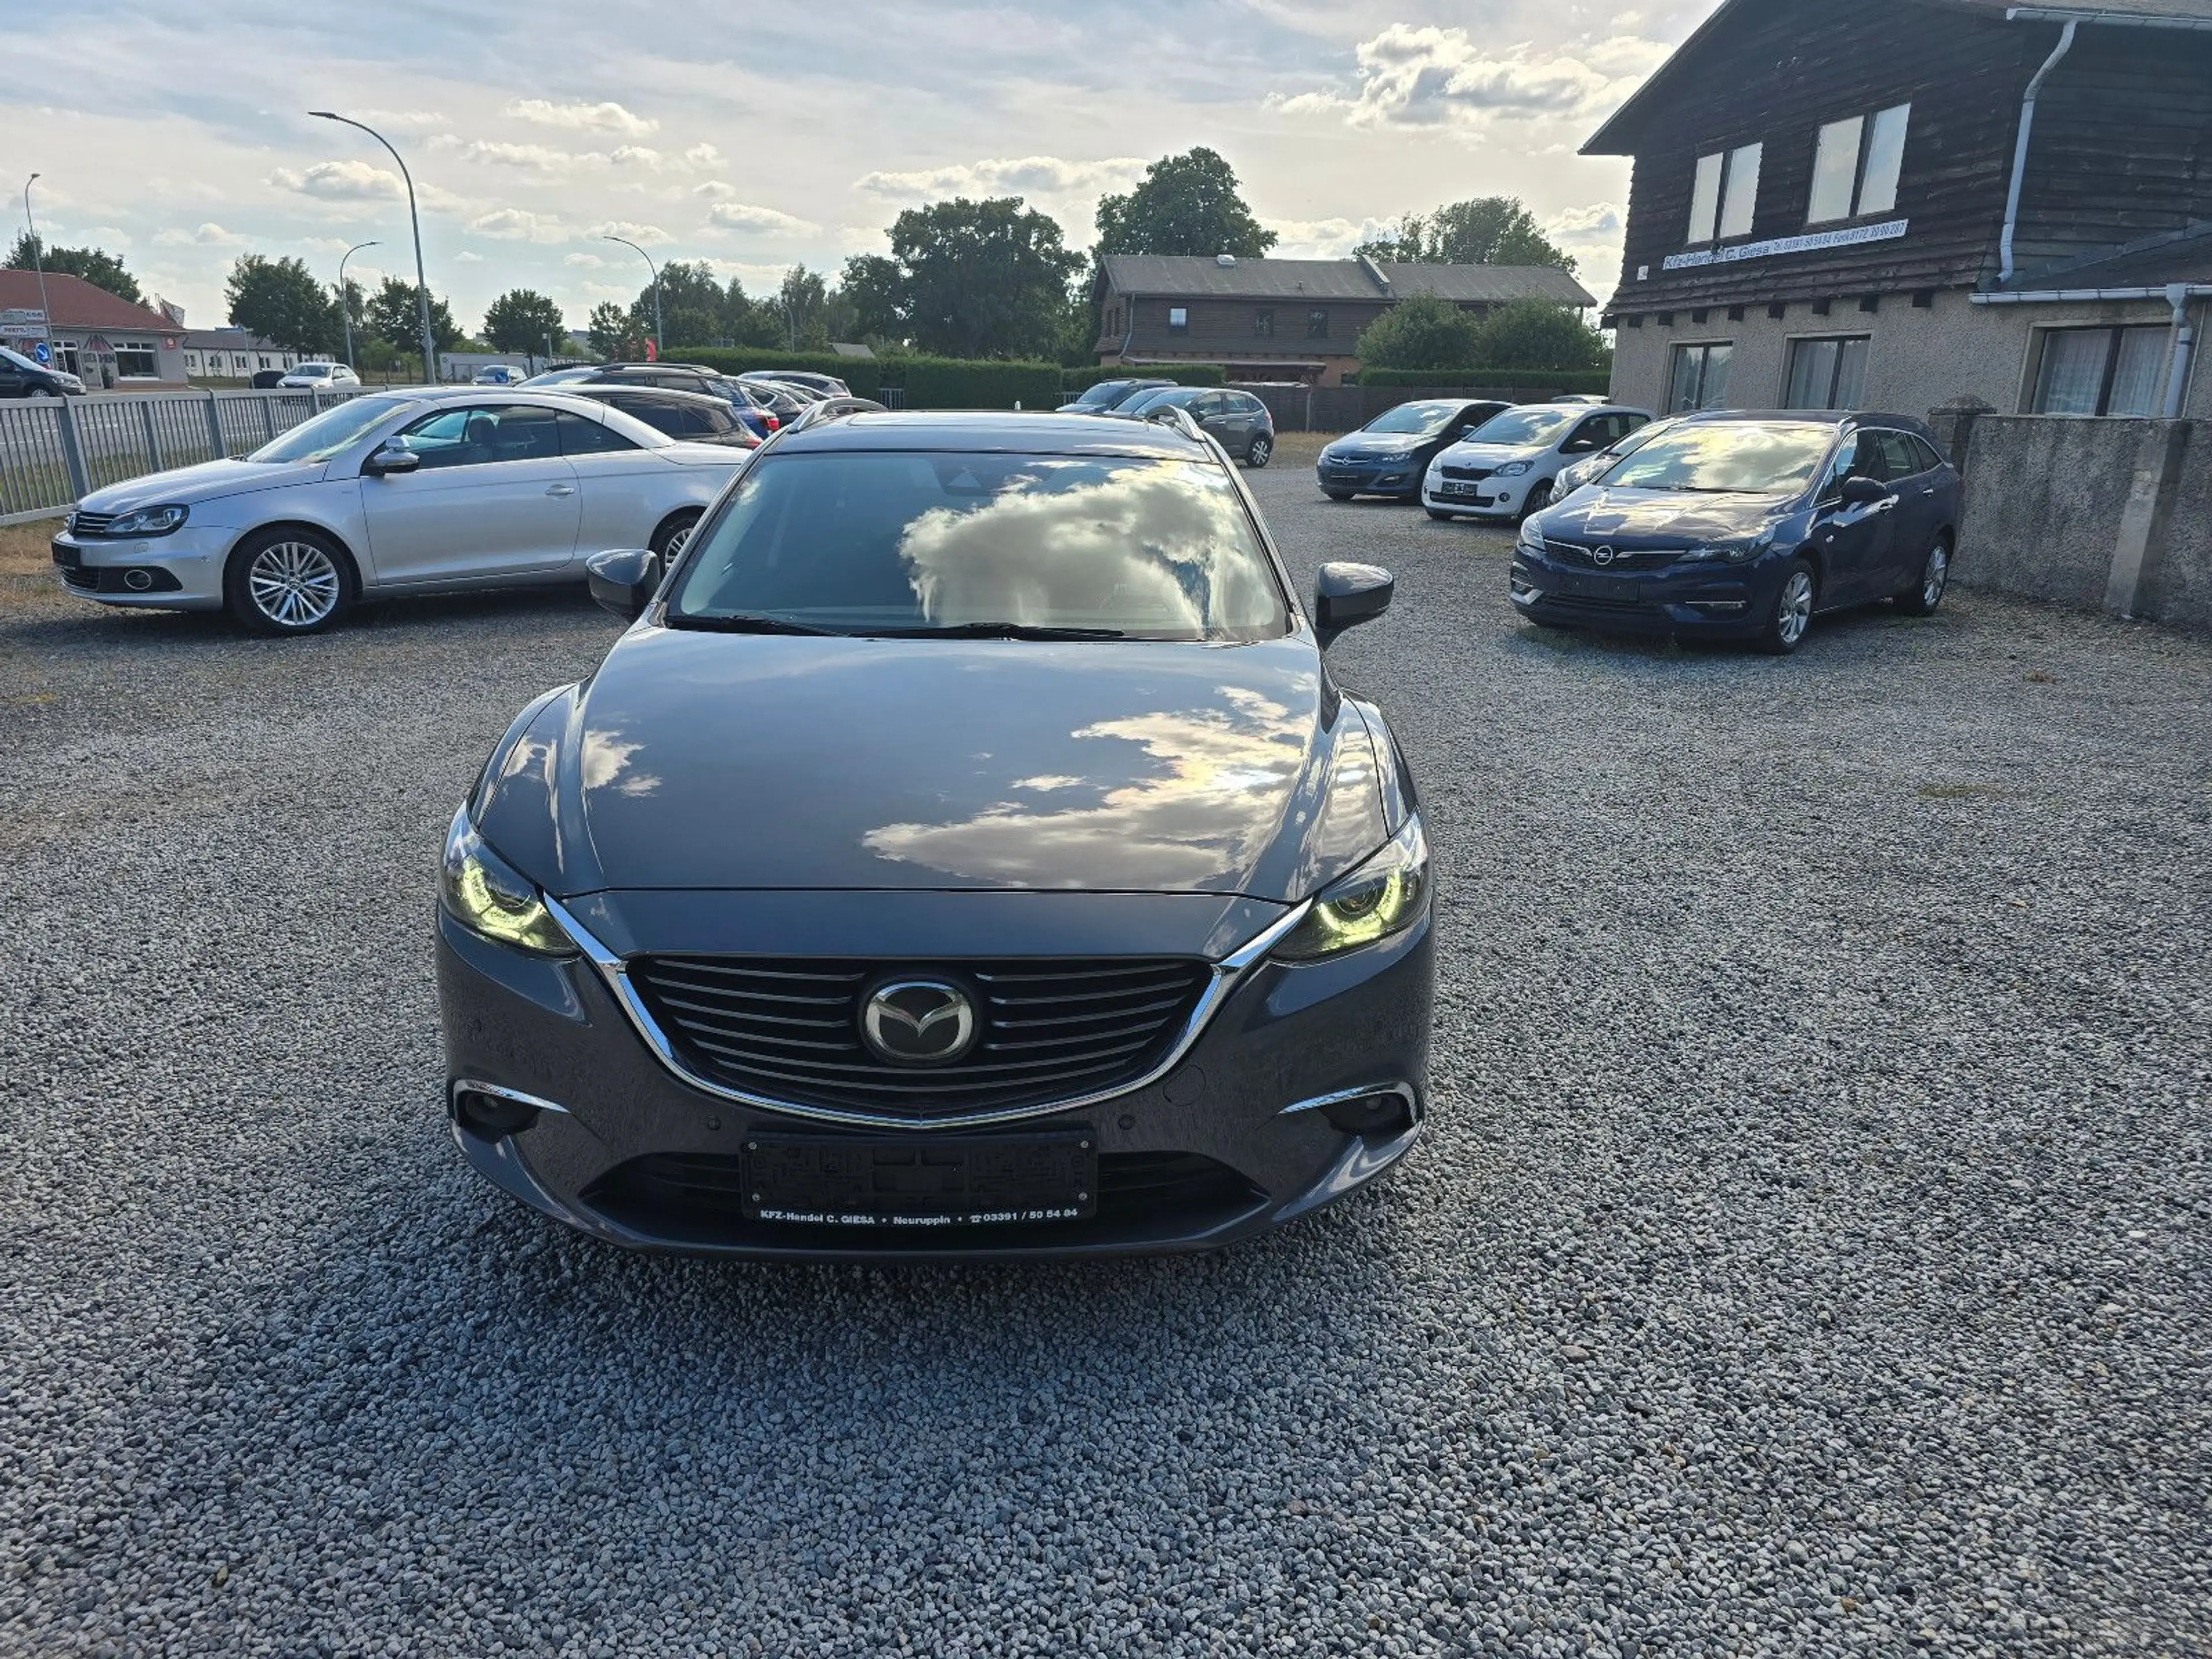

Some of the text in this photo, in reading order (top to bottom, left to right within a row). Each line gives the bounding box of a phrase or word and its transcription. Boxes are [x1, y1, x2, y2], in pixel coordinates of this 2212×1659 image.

[1726, 249, 1736, 260] C.
[1739, 245, 1770, 257] Giesa
[760, 1209, 824, 1222] KFZ-Handel
[827, 1214, 839, 1223] C.
[840, 1215, 876, 1224] GIESA
[893, 1215, 951, 1226] Neuruppin
[983, 1212, 1017, 1221] 03391
[1029, 1210, 1043, 1219] 50
